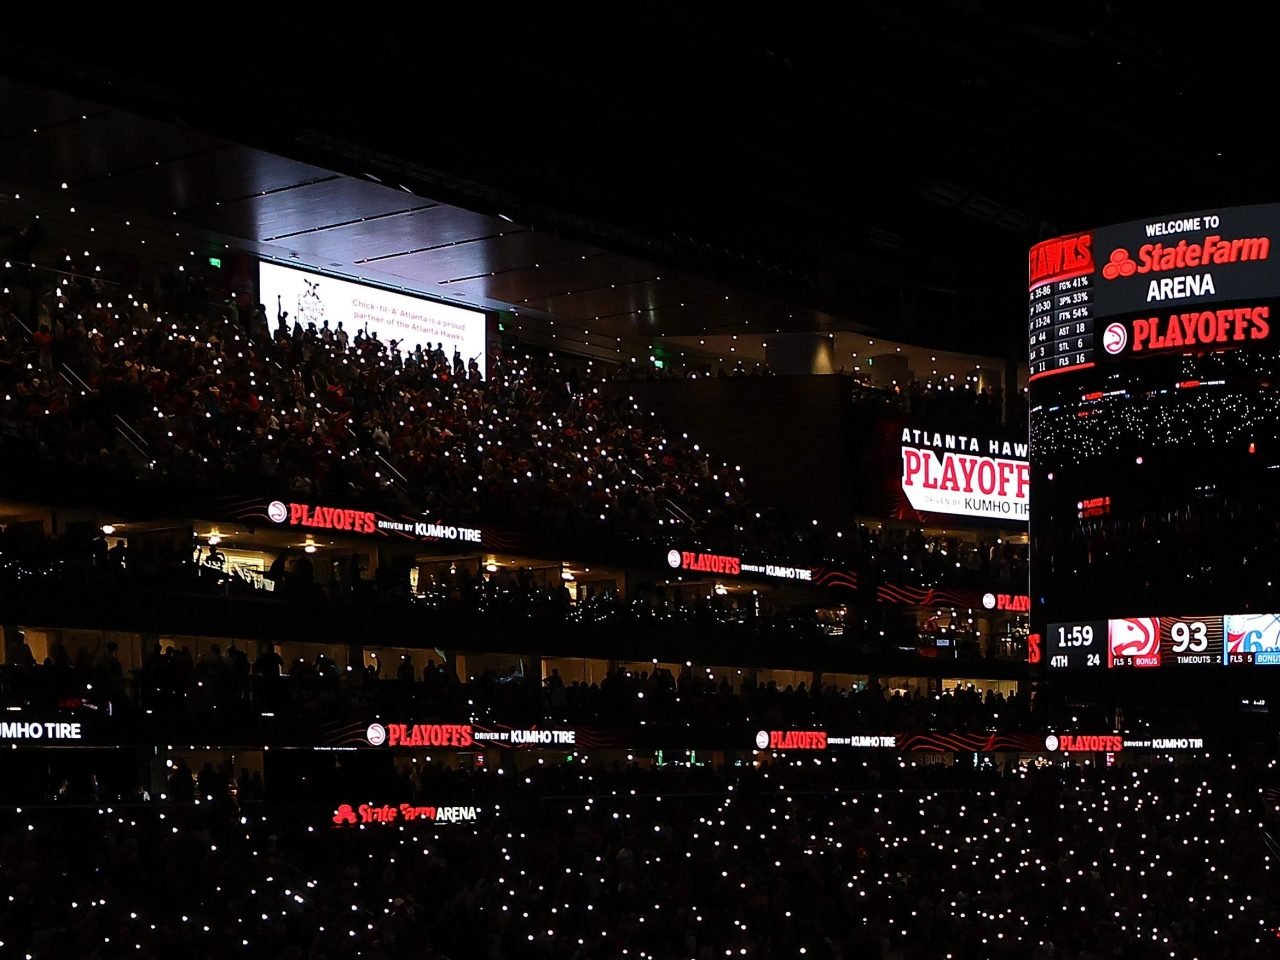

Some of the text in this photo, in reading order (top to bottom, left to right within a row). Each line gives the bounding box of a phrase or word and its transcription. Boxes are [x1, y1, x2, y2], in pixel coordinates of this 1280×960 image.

[1146, 215, 1220, 237] WELCOME TO
[1058, 276, 1088, 291] FG% 41%
[1146, 273, 1216, 302] ARENA
[1059, 291, 1088, 306] 3P% 33%
[400, 309, 428, 323] Atlanta
[443, 321, 465, 331] proud
[1058, 306, 1088, 321] FT% 54%
[353, 312, 384, 324] partner
[411, 323, 439, 336] Atlanta
[1058, 323, 1085, 336] AST 18
[1132, 306, 1271, 351] PLAYOFFS
[1058, 338, 1083, 351] STL 6
[1058, 353, 1085, 367] FLS 16
[902, 427, 979, 452] ATLANTA
[964, 498, 1010, 514] KUMHO
[289, 503, 481, 543] PLAYOFFS DRIVEN BY KUMHO TIRE
[681, 551, 741, 575] PLAYOFFS
[741, 564, 760, 573] DRIVEN
[766, 565, 795, 579] KUMHO
[795, 569, 812, 581] TIRE
[1058, 625, 1094, 648] 1:59
[1170, 622, 1208, 653] 93
[1050, 654, 1101, 667] 4TH 24
[1113, 658, 1158, 666] FLS 5 BONUS
[1177, 655, 1222, 664] TIMEOUTS 2
[1230, 654, 1243, 663] FLS
[1247, 654, 1253, 663] 5
[0, 722, 82, 739] MHO TIRE
[388, 723, 576, 747] PLAYOFFS DRIVEN BY KUMHO TIRE
[769, 731, 827, 750] PLAYOFFS
[851, 735, 880, 748] KUMHO
[879, 736, 896, 748] TIRE
[1059, 735, 1122, 751] PLAYOFFS
[1123, 740, 1144, 748] DRIVEN
[1152, 738, 1188, 749] KUMHO
[436, 806, 477, 821] ARENA
